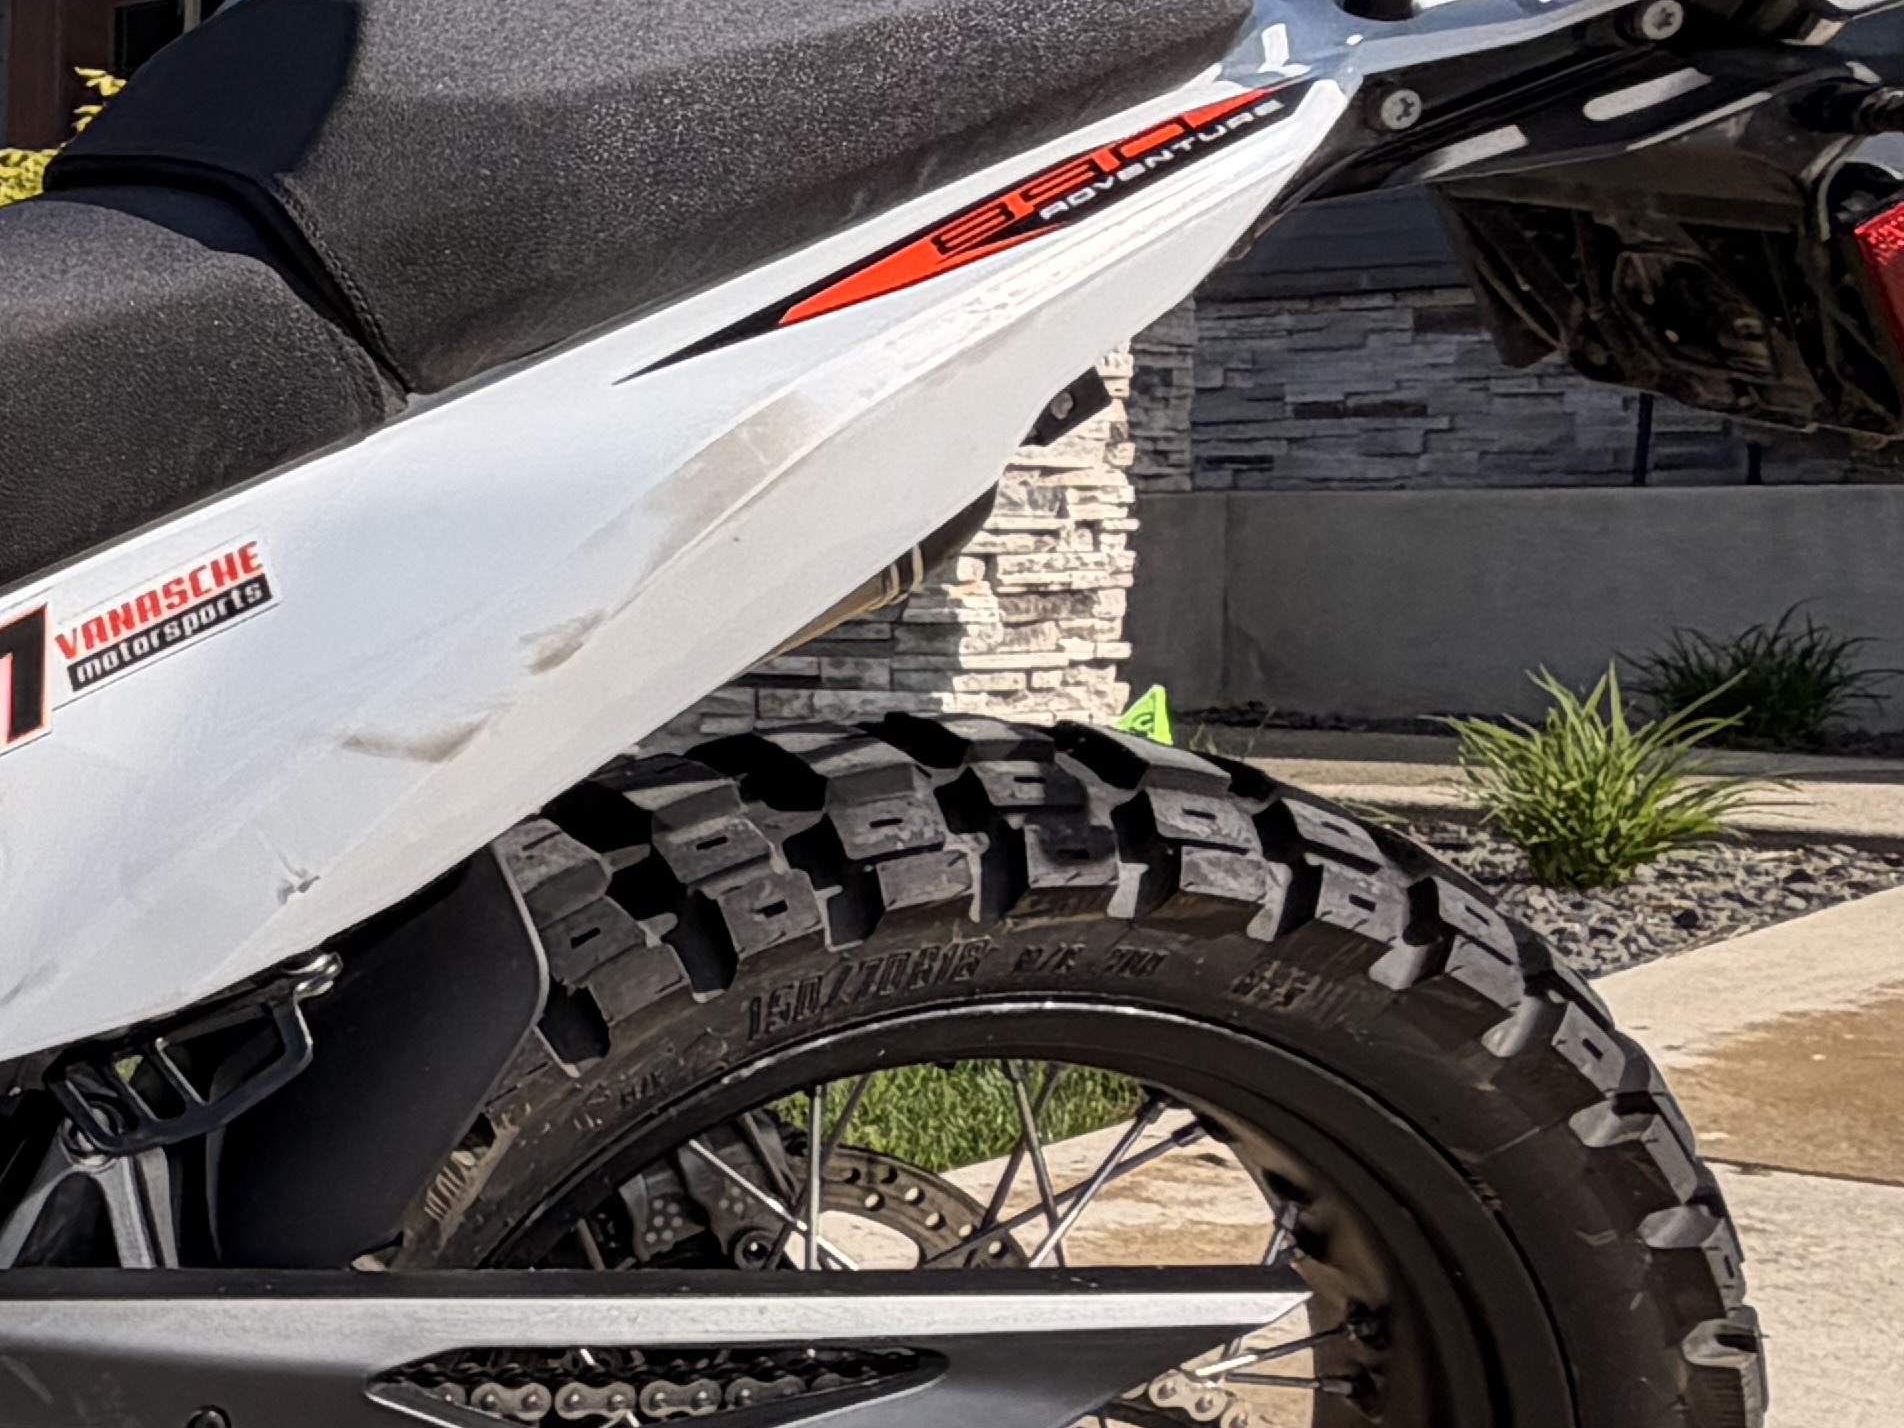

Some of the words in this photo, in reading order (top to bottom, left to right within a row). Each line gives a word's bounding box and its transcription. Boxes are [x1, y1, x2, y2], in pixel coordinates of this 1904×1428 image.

[1040, 100, 1285, 220] ADVENTURE
[55, 540, 264, 660] VANASCHE
[76, 581, 265, 684] motorsports
